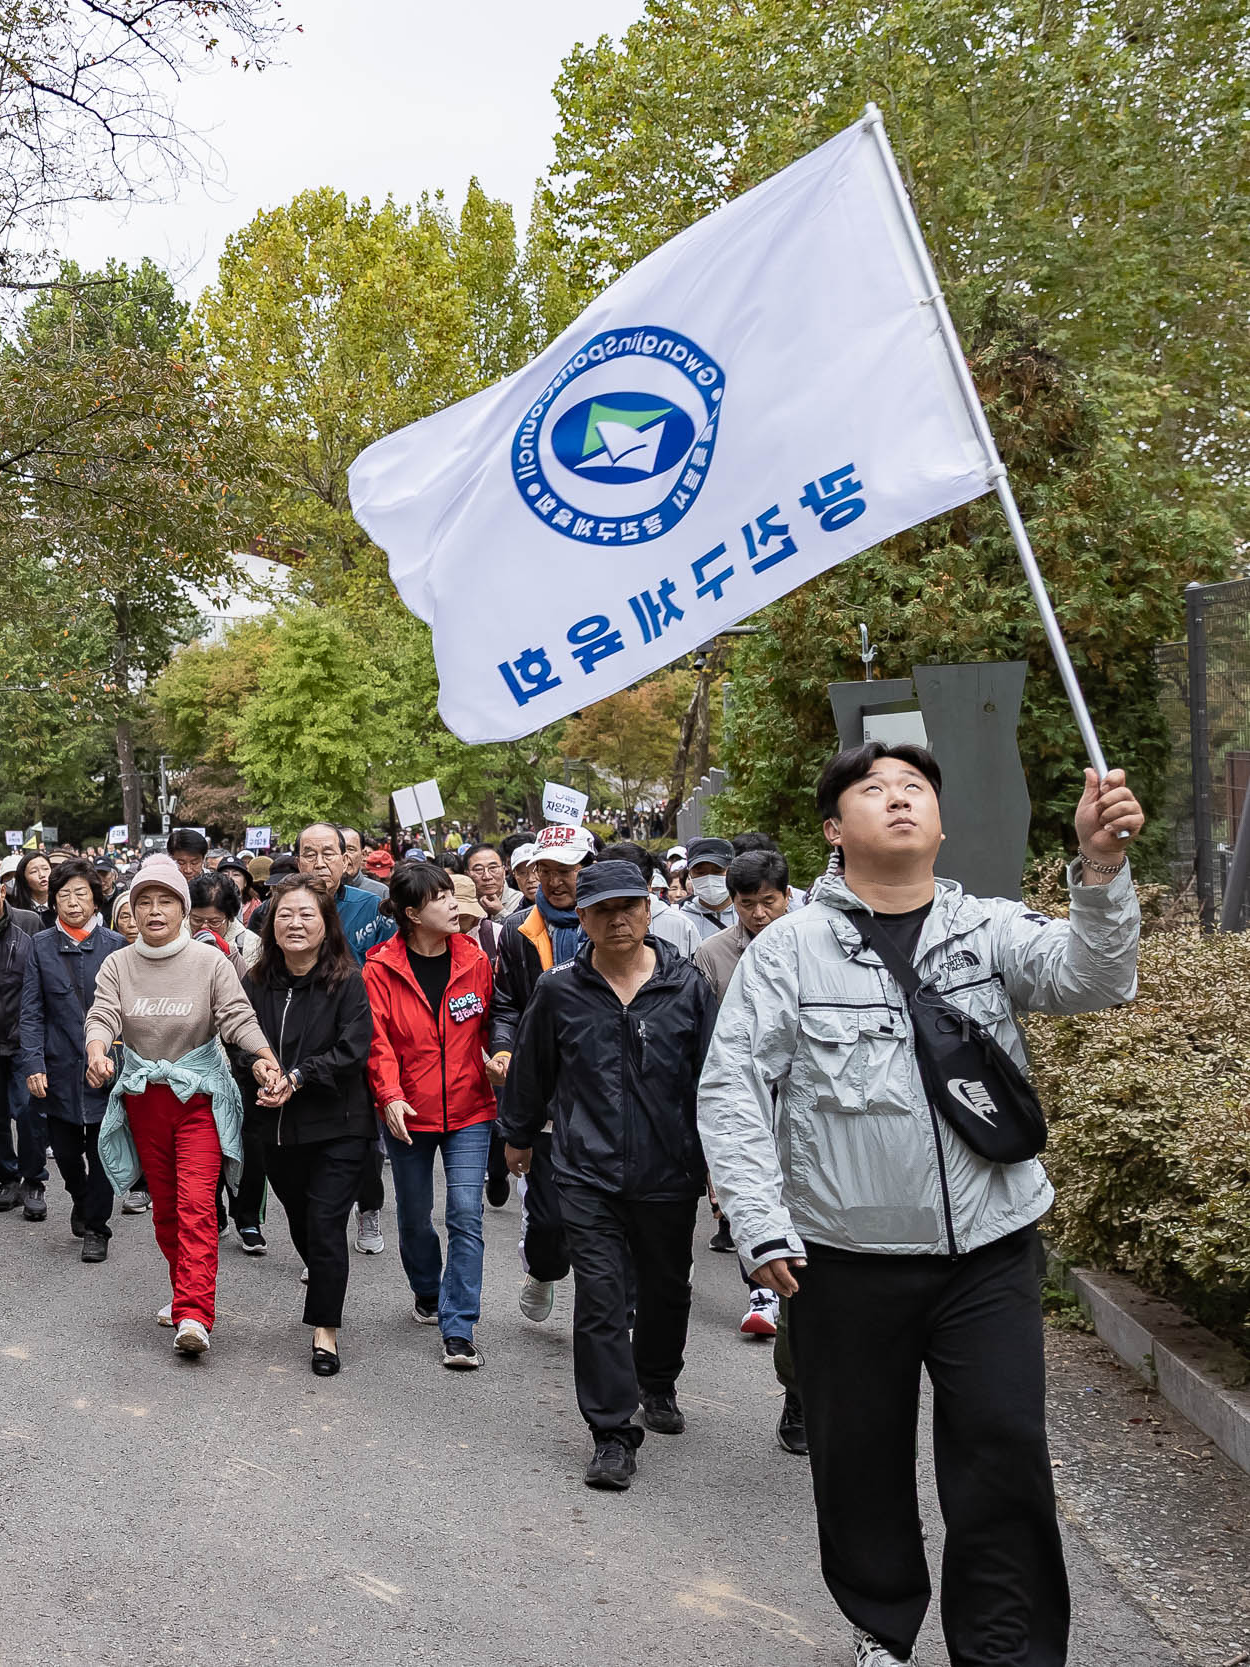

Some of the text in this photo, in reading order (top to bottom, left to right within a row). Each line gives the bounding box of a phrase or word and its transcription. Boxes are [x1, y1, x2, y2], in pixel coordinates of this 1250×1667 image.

[546, 801, 579, 818] 자양2동
[538, 827, 575, 843] JEEP
[939, 957, 965, 970] NORTH
[947, 952, 962, 961] THE
[125, 997, 193, 1016] Mellow
[962, 1081, 998, 1114] NIKE
